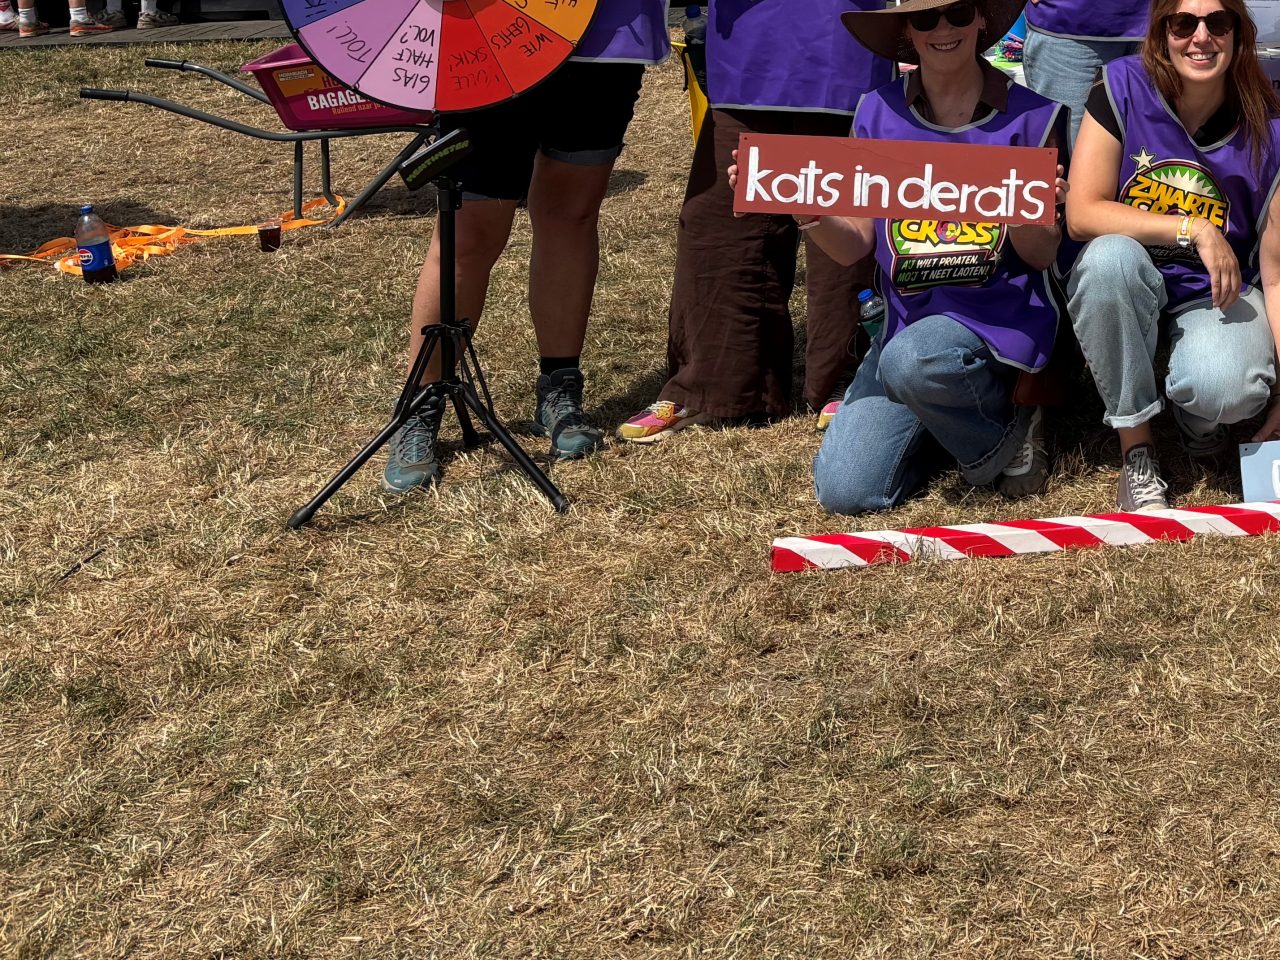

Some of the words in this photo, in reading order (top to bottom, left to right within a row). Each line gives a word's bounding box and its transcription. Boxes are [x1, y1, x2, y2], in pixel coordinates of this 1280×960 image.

[490, 16, 531, 50] GEHTS
[519, 32, 553, 57] WIE
[392, 47, 434, 68] HALF
[745, 146, 844, 207] kats
[853, 165, 890, 209] in
[1129, 175, 1227, 228] ZWARTE
[916, 258, 938, 268] WILT
[929, 268, 953, 279] NEET
